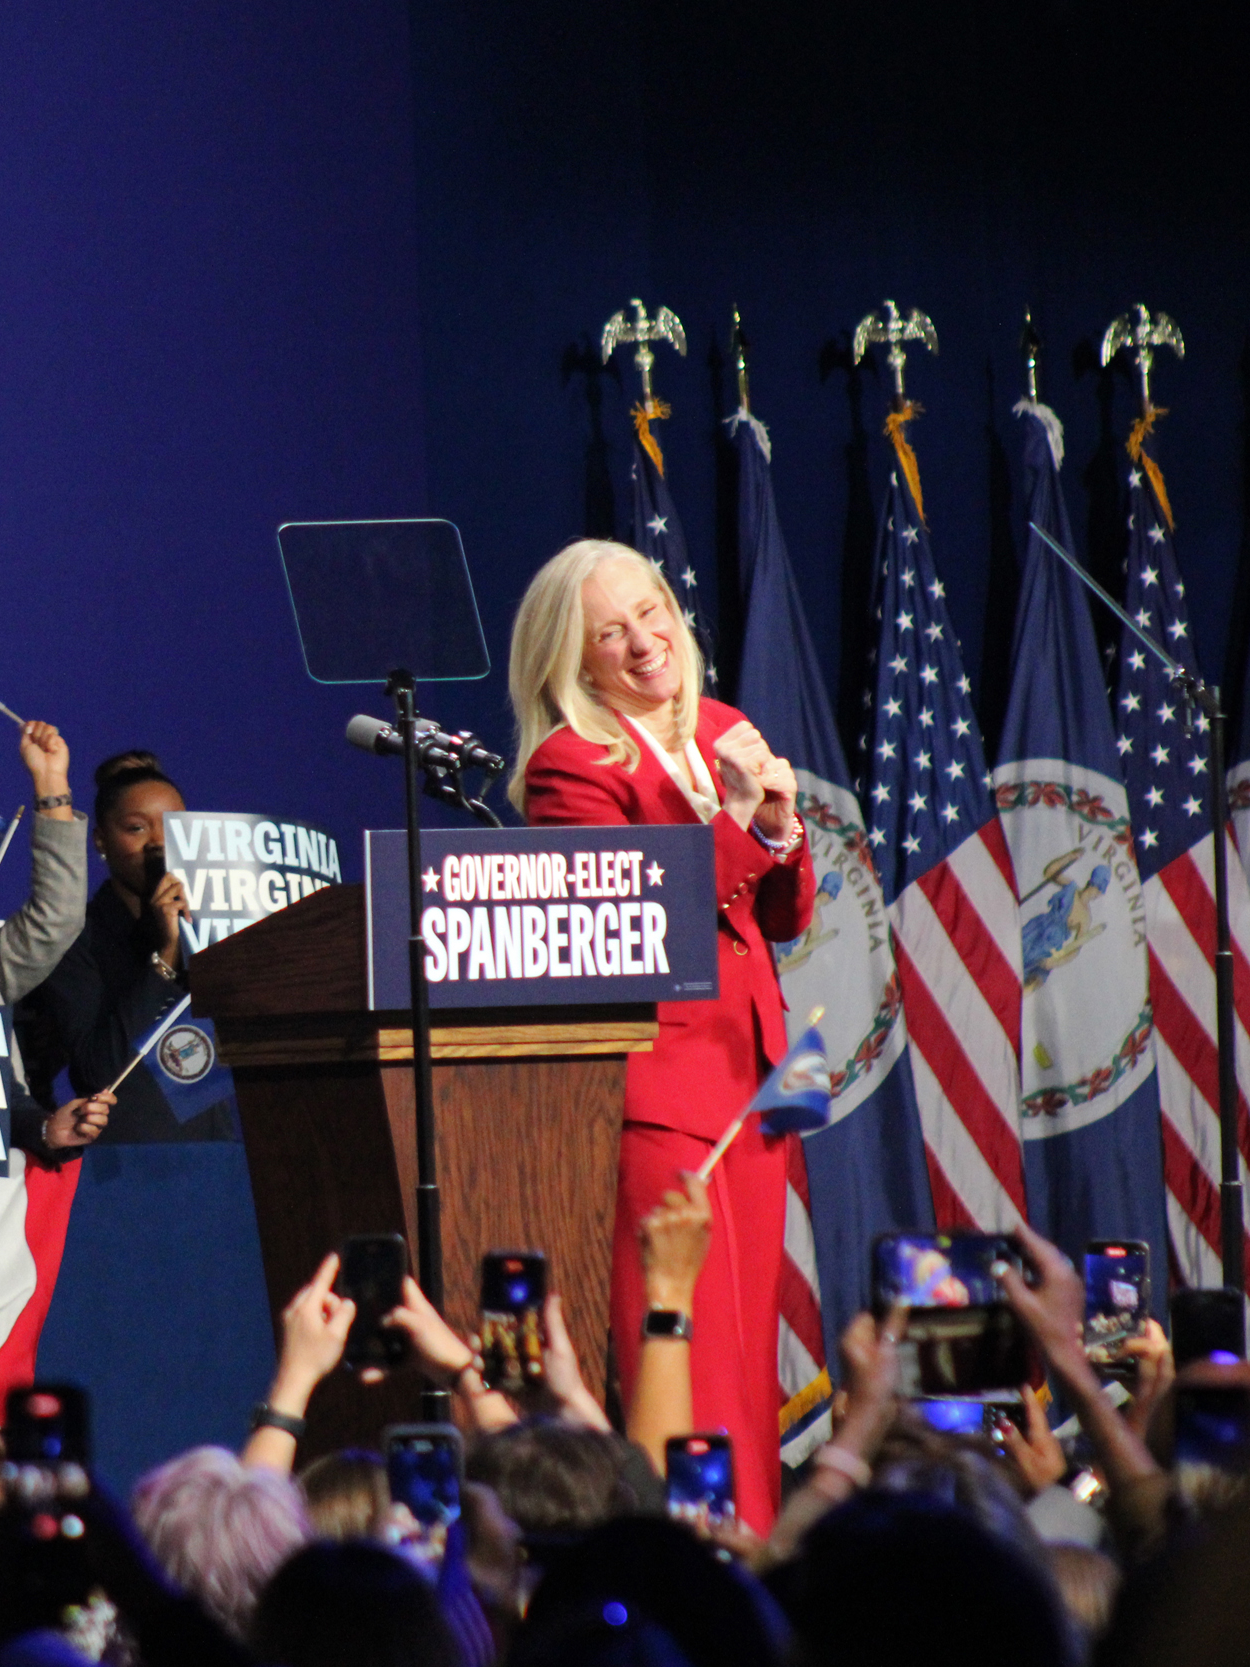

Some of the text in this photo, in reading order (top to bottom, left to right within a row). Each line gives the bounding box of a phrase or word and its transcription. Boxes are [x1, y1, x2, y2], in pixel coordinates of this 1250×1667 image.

[169, 818, 342, 884] VIRGINIA
[443, 851, 643, 901] GOVERNOR-ELECT
[421, 902, 670, 982] SPANBERGER
